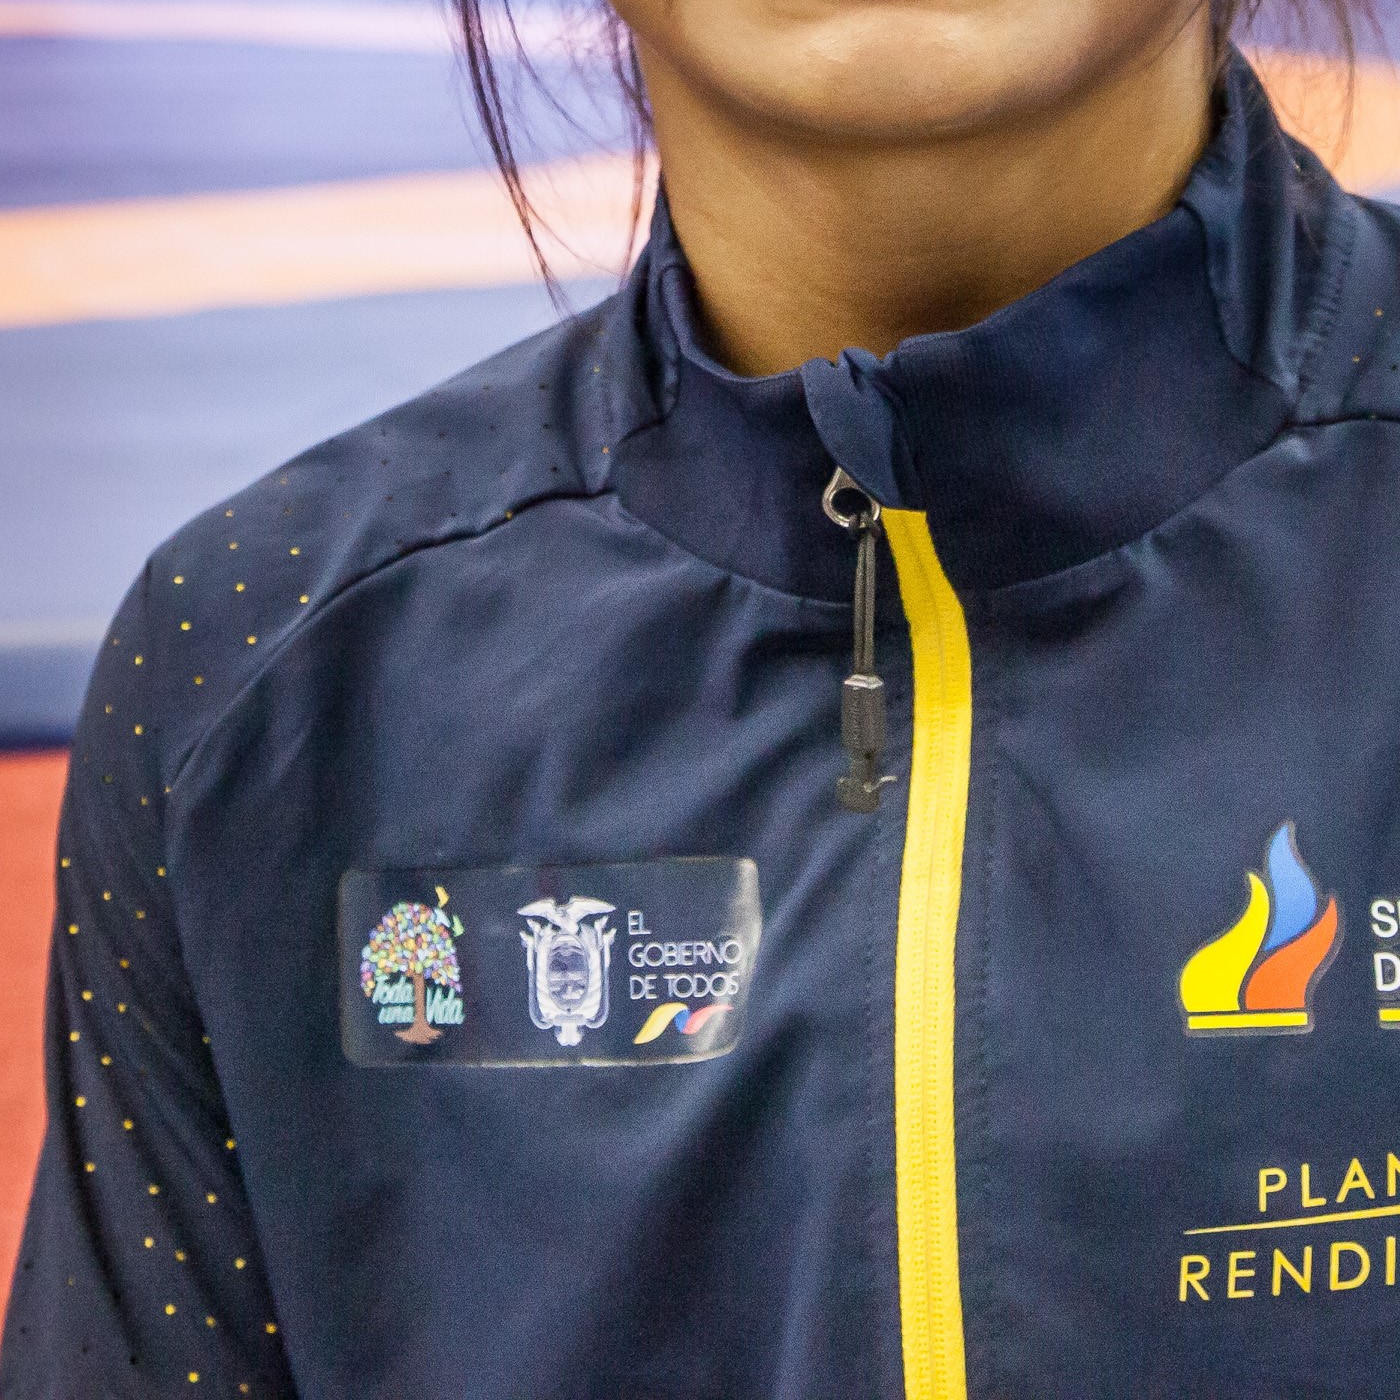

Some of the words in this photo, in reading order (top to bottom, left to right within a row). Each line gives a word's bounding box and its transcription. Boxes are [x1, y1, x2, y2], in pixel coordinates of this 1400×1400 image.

[628, 910, 652, 935] EL
[628, 940, 741, 967] GOBIERNO
[629, 974, 658, 999] DE
[662, 971, 740, 998] TODOS
